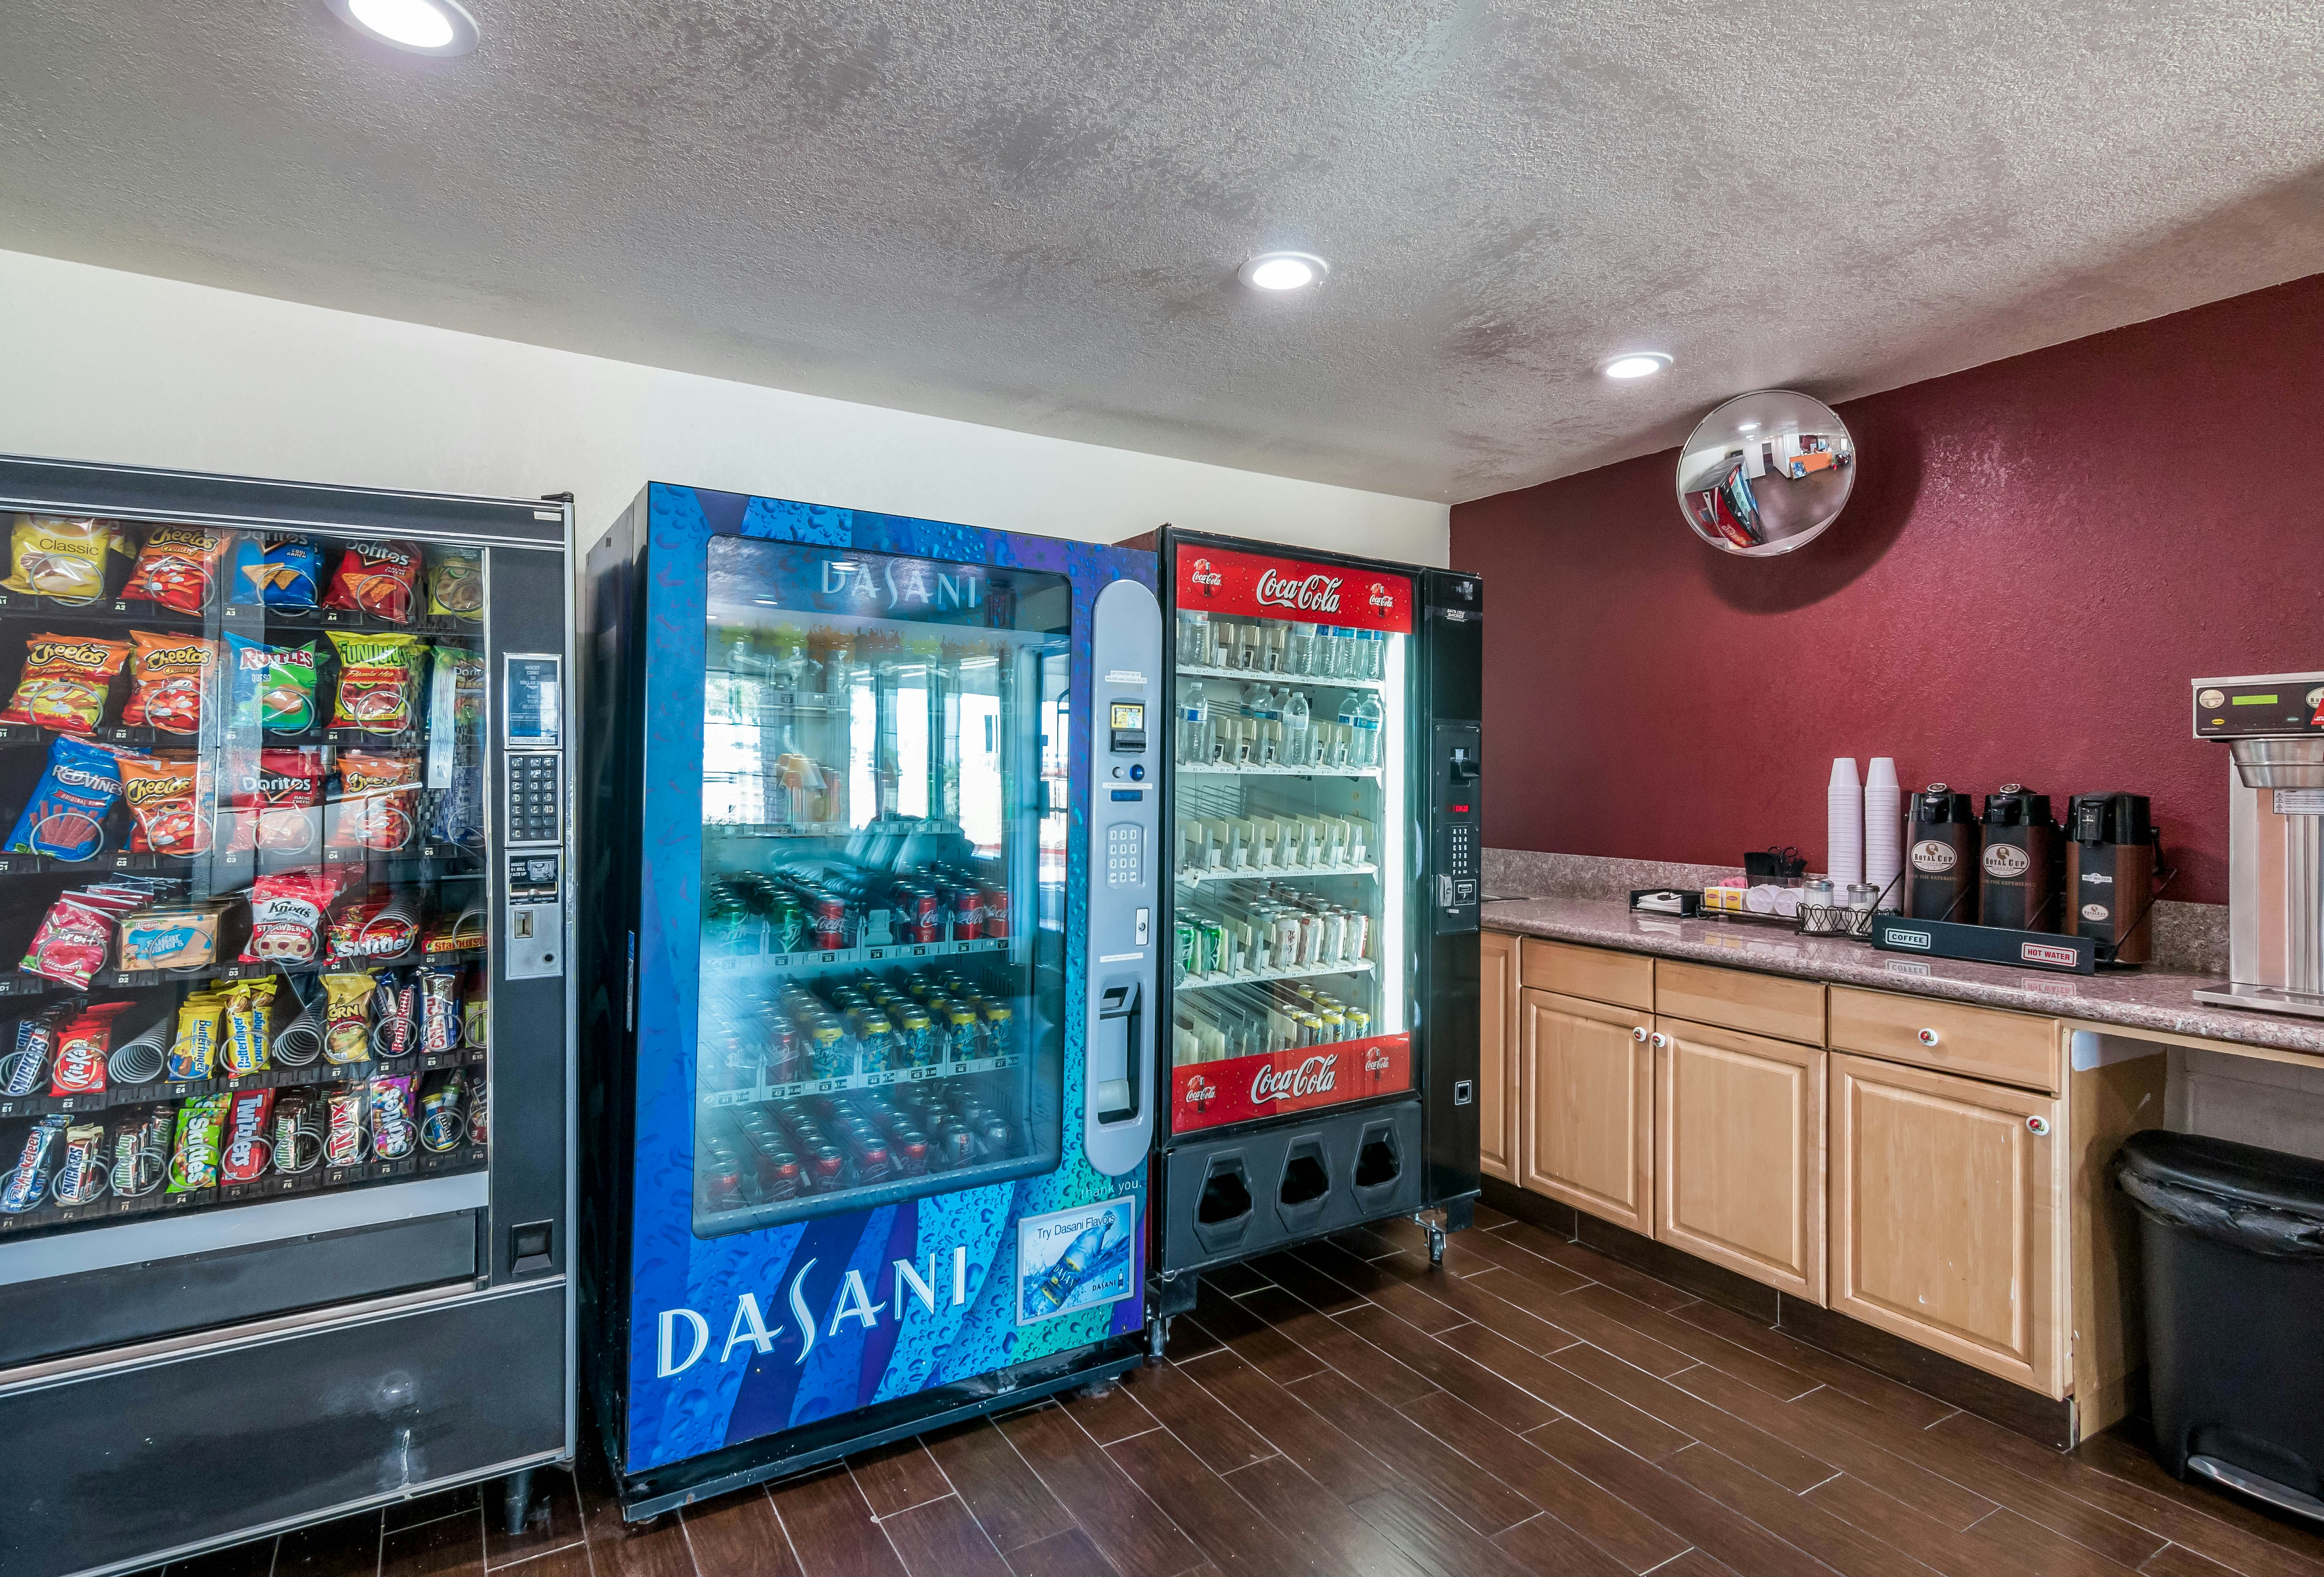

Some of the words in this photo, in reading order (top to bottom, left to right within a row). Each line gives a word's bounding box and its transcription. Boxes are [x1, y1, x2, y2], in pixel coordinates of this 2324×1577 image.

[40, 538, 99, 556] Classic
[148, 526, 219, 551] Cheetos
[161, 546, 197, 555] Crunchy
[345, 539, 409, 565] Doritos
[820, 558, 976, 609] DASANI
[1192, 571, 1222, 587] Coca-Cola
[1256, 568, 1343, 613] Coca-Cola
[1369, 594, 1393, 608] Coca-Cola
[28, 644, 110, 666] Cheetos
[147, 647, 213, 671] Cheetos
[163, 666, 198, 674] Crunchy
[252, 674, 271, 682] QUESO
[243, 777, 311, 791] Doritos
[61, 793, 87, 805] ORIGINAL
[1986, 858, 2006, 866] ROYAL
[268, 901, 311, 918] Knott's
[136, 922, 160, 930] Keebler
[1892, 934, 1924, 943] COFFEE
[2027, 948, 2041, 957] HOT
[2045, 951, 2070, 961] WATER
[44, 959, 82, 970] Strawberry
[328, 1003, 360, 1021] CORN
[195, 1019, 212, 1072] Butterfinger
[233, 1017, 252, 1069] Butterfinger
[9, 1037, 47, 1094] SNICKERS
[1365, 1056, 1389, 1072] Coca-Cola
[1250, 1053, 1339, 1104] Coca-Cola
[1186, 1083, 1216, 1103] Coca-Cola
[330, 1103, 355, 1158] TWIX
[381, 1089, 407, 1154] Skittles
[187, 1117, 209, 1183] Skittles
[62, 1147, 84, 1196] SNICKERS
[1081, 1183, 1114, 1199] thank
[1119, 1180, 1142, 1194] you.
[1037, 1228, 1052, 1240] Try
[1054, 1220, 1084, 1236] Dasani
[1092, 1280, 1116, 1292] DASANI
[657, 1245, 967, 1379] DASANI
